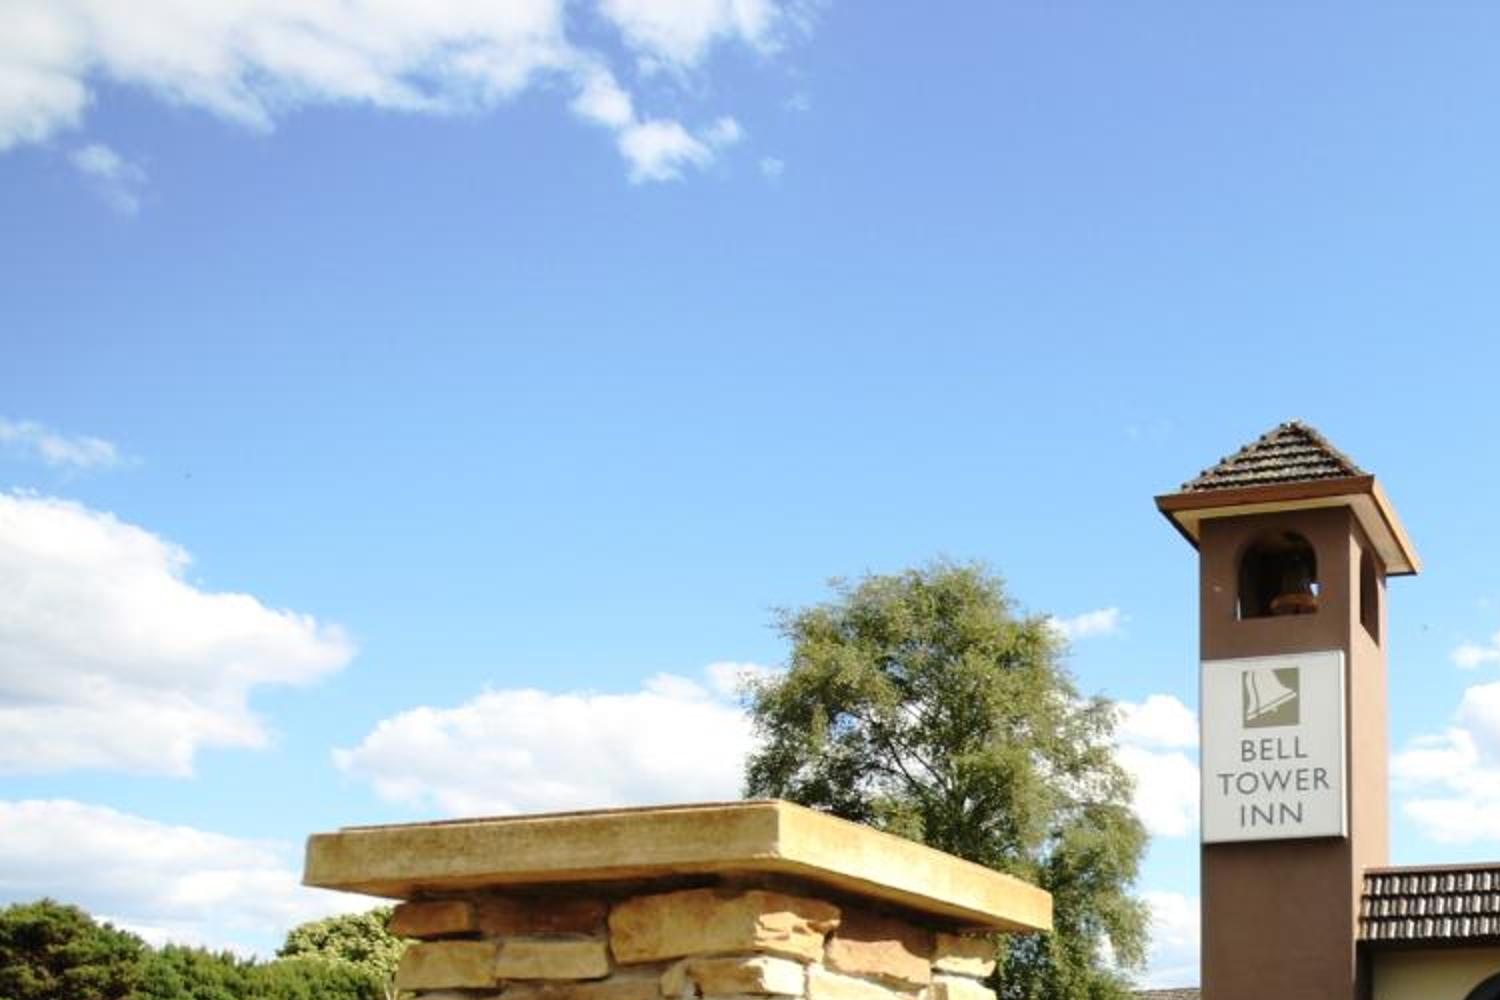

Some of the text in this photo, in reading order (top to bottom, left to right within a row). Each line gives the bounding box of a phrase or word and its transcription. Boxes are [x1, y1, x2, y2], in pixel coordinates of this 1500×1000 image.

[1241, 736, 1308, 762] BELL
[1217, 767, 1330, 795] TOWER
[1240, 801, 1303, 828] INN
